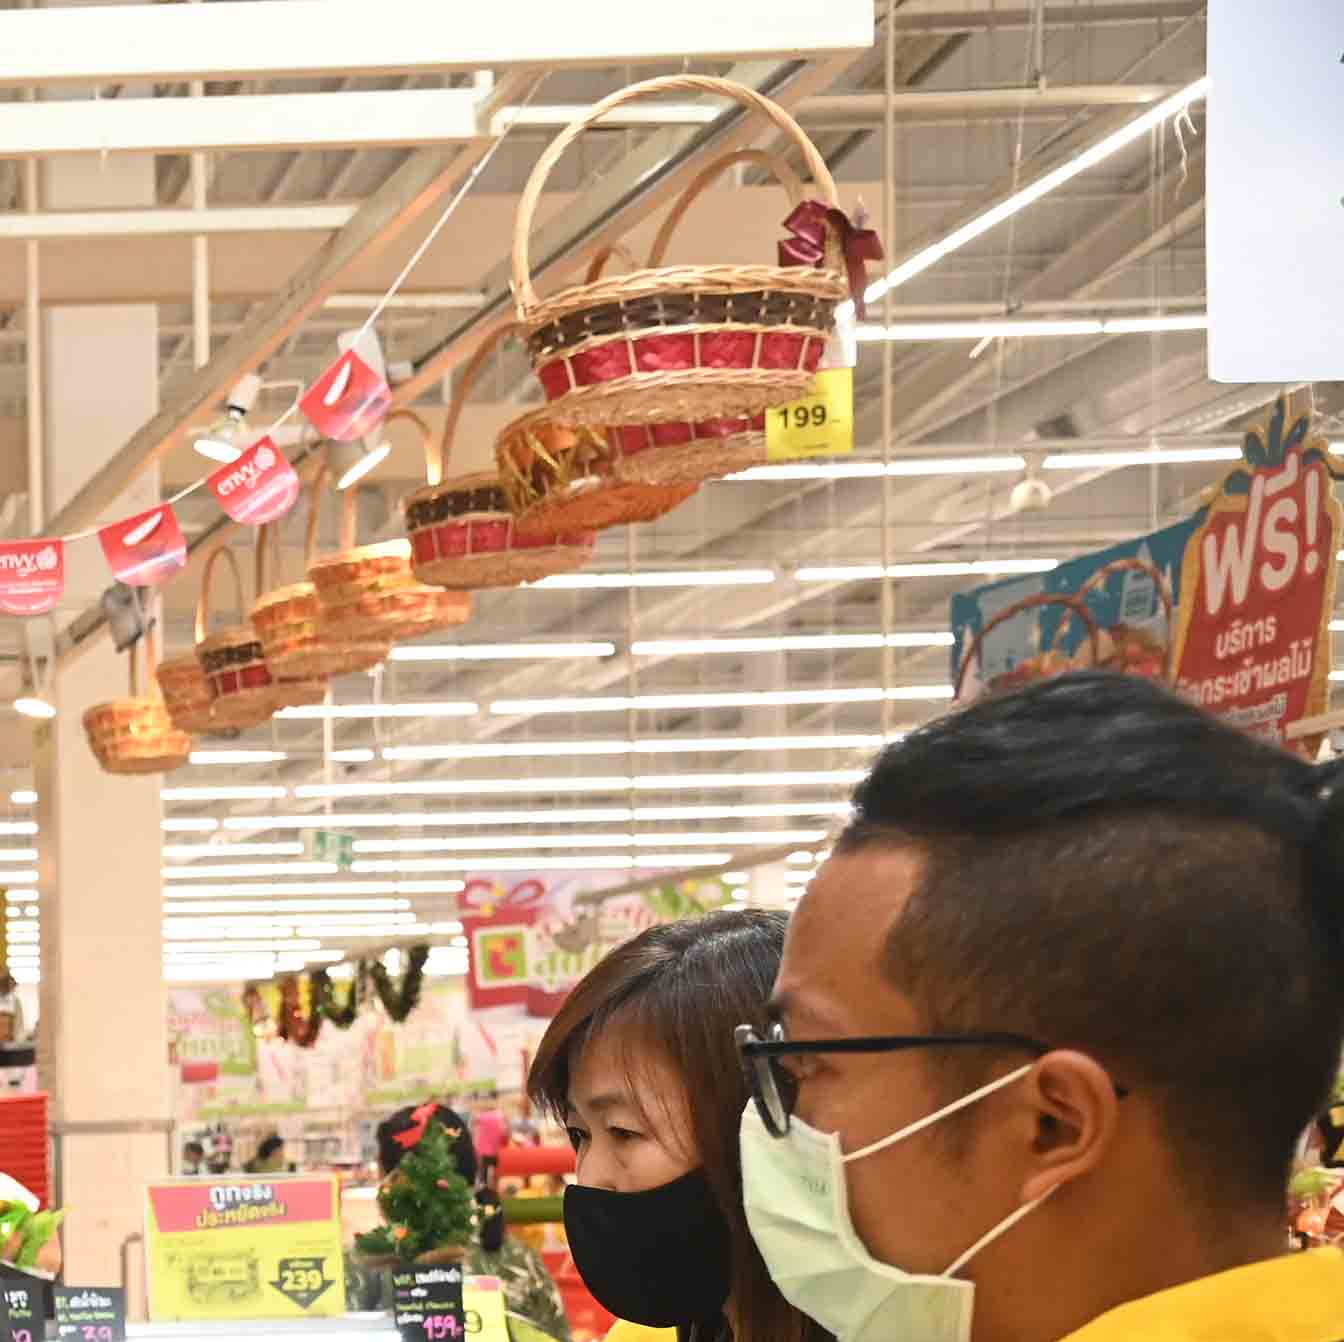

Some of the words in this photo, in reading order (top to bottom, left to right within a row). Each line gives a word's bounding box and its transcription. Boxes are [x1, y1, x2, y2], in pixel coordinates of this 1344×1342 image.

[777, 404, 827, 429] 199
[1201, 452, 1320, 615] ฟรี!
[281, 1269, 323, 1291] 239
